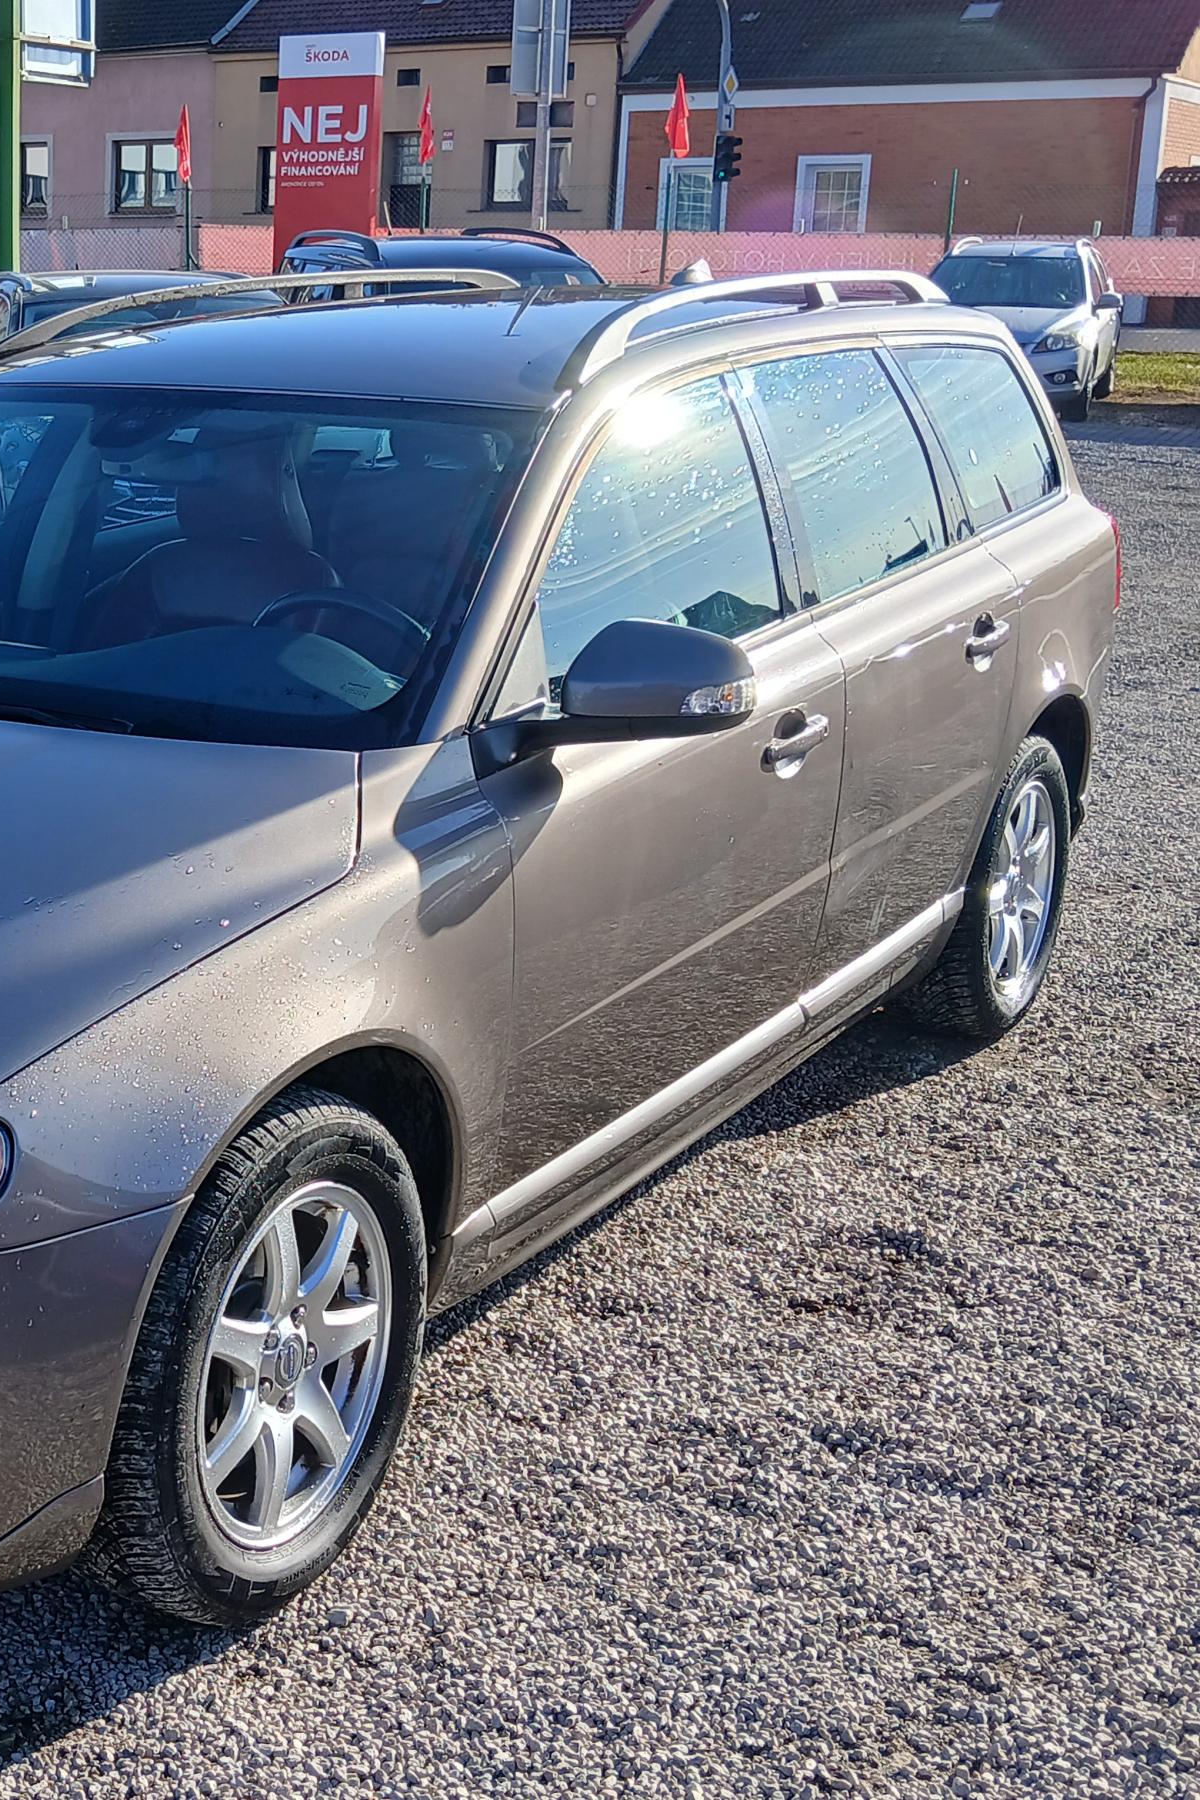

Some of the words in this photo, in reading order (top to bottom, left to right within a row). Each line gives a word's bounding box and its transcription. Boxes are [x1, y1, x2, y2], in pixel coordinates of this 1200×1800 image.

[305, 48, 350, 63] ŠKODA
[282, 104, 369, 144] NEJ
[282, 147, 365, 163] VÝHODNĚJŠÍ
[280, 163, 359, 177] FINANCOVÁNÍ
